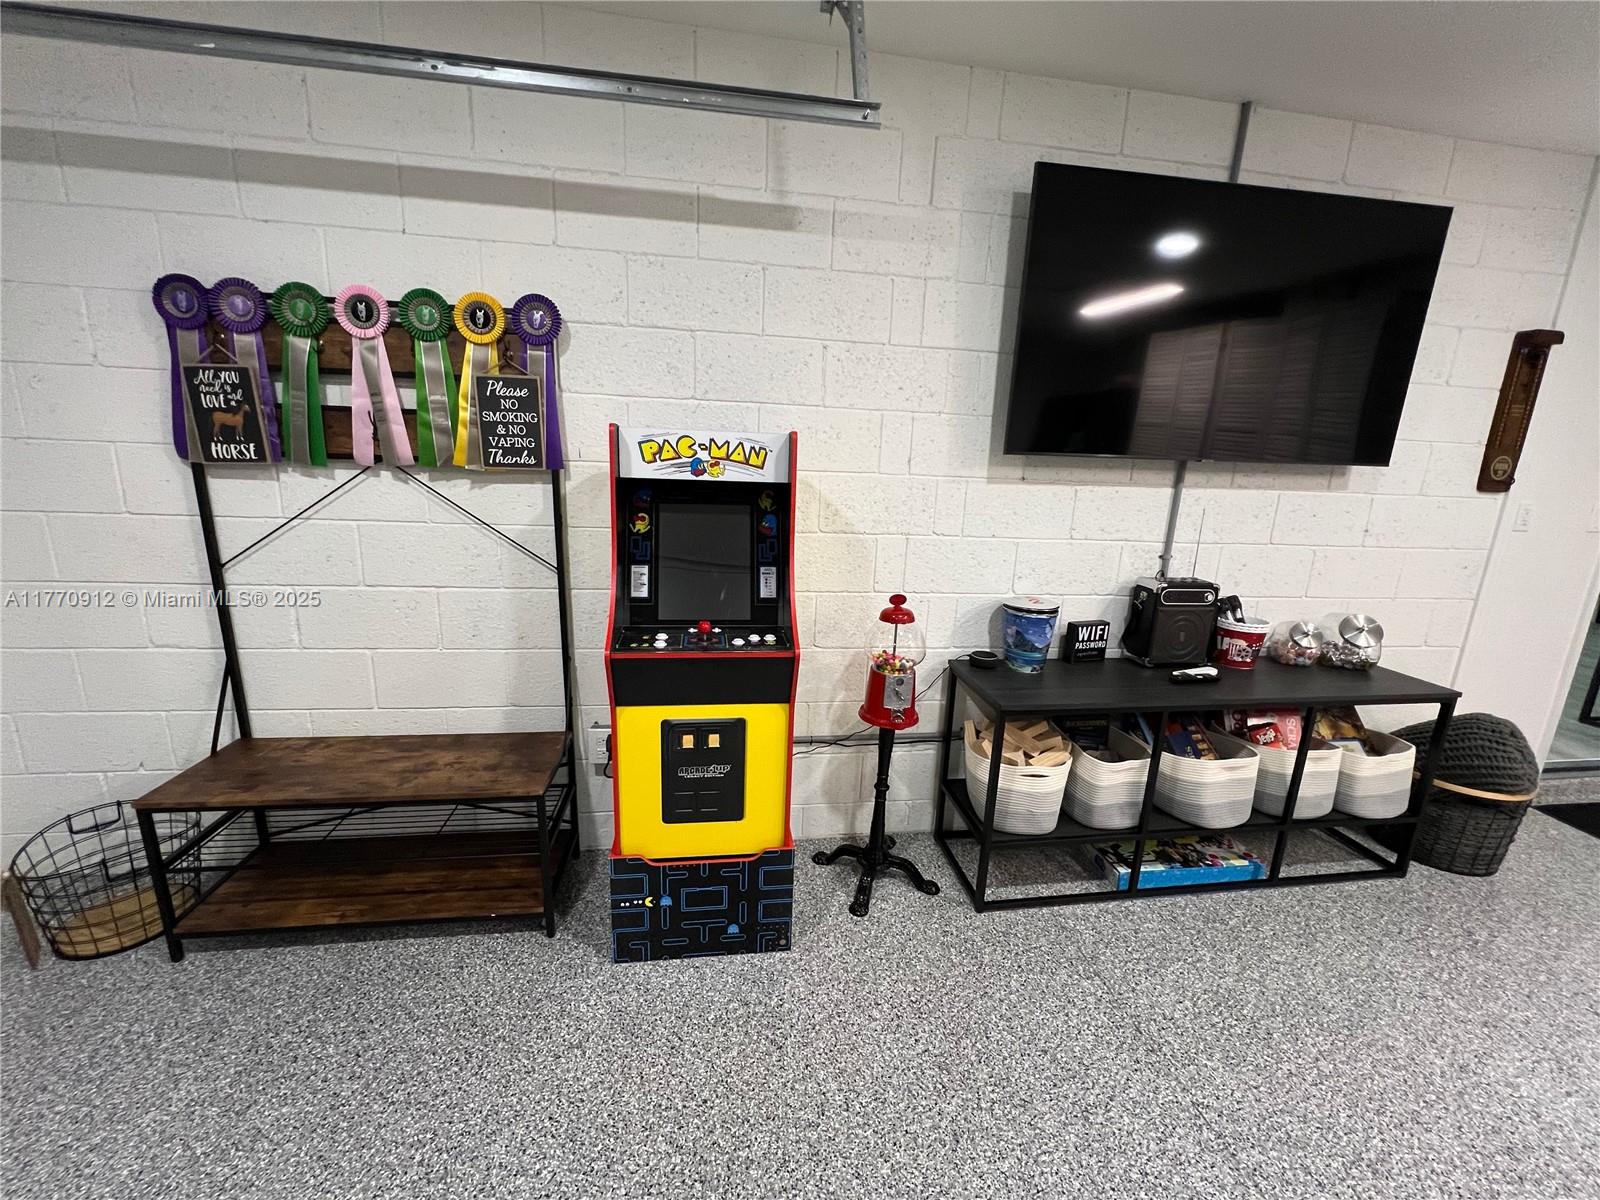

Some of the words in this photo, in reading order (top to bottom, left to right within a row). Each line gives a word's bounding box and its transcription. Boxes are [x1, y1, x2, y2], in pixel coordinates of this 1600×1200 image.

[194, 369, 216, 384] All
[218, 371, 240, 383] YOU
[199, 380, 222, 393] need
[224, 384, 232, 392] is
[486, 380, 529, 397] Please
[200, 393, 227, 408] LOVE
[500, 399, 518, 409] NO
[482, 411, 538, 423] SMOKING
[496, 424, 506, 434] &
[508, 425, 526, 435] NO
[489, 437, 535, 448] VAPING
[210, 442, 258, 459] HORSE
[488, 449, 537, 465] Thanks
[638, 435, 768, 470] PAC-MAN
[1078, 625, 1108, 642] WIFI
[1074, 641, 1107, 650] PASSWORD
